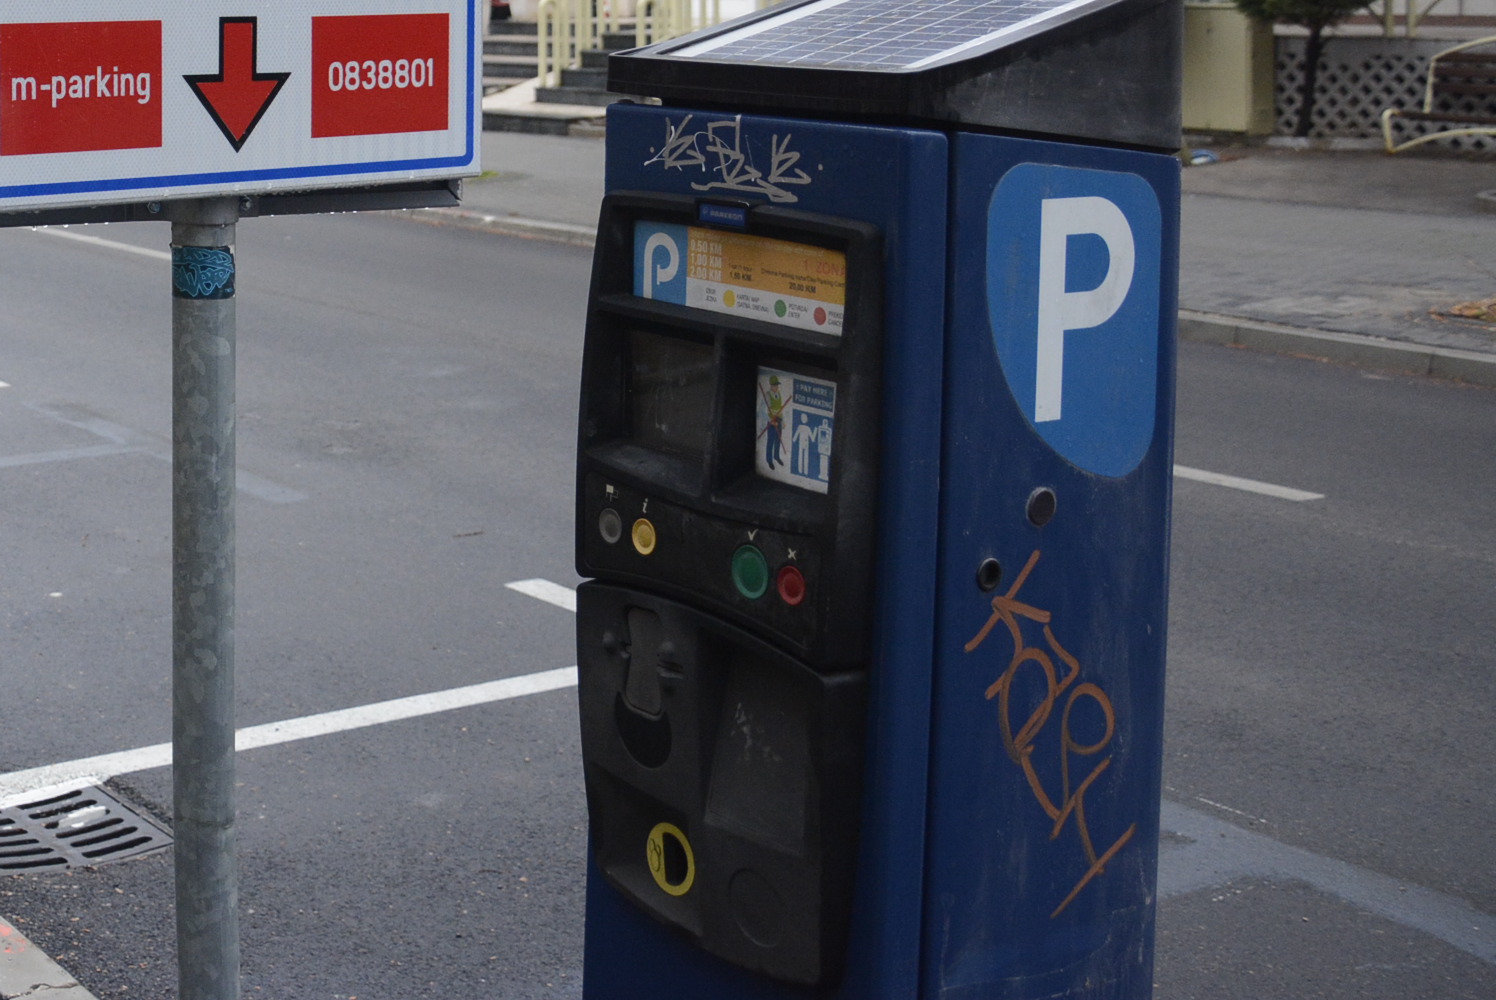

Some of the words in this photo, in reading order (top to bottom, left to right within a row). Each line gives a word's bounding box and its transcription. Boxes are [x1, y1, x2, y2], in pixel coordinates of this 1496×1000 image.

[10, 65, 152, 108] m-parking
[327, 57, 435, 92] 0838801
[1034, 196, 1136, 423] P
[800, 383, 812, 394] PAY
